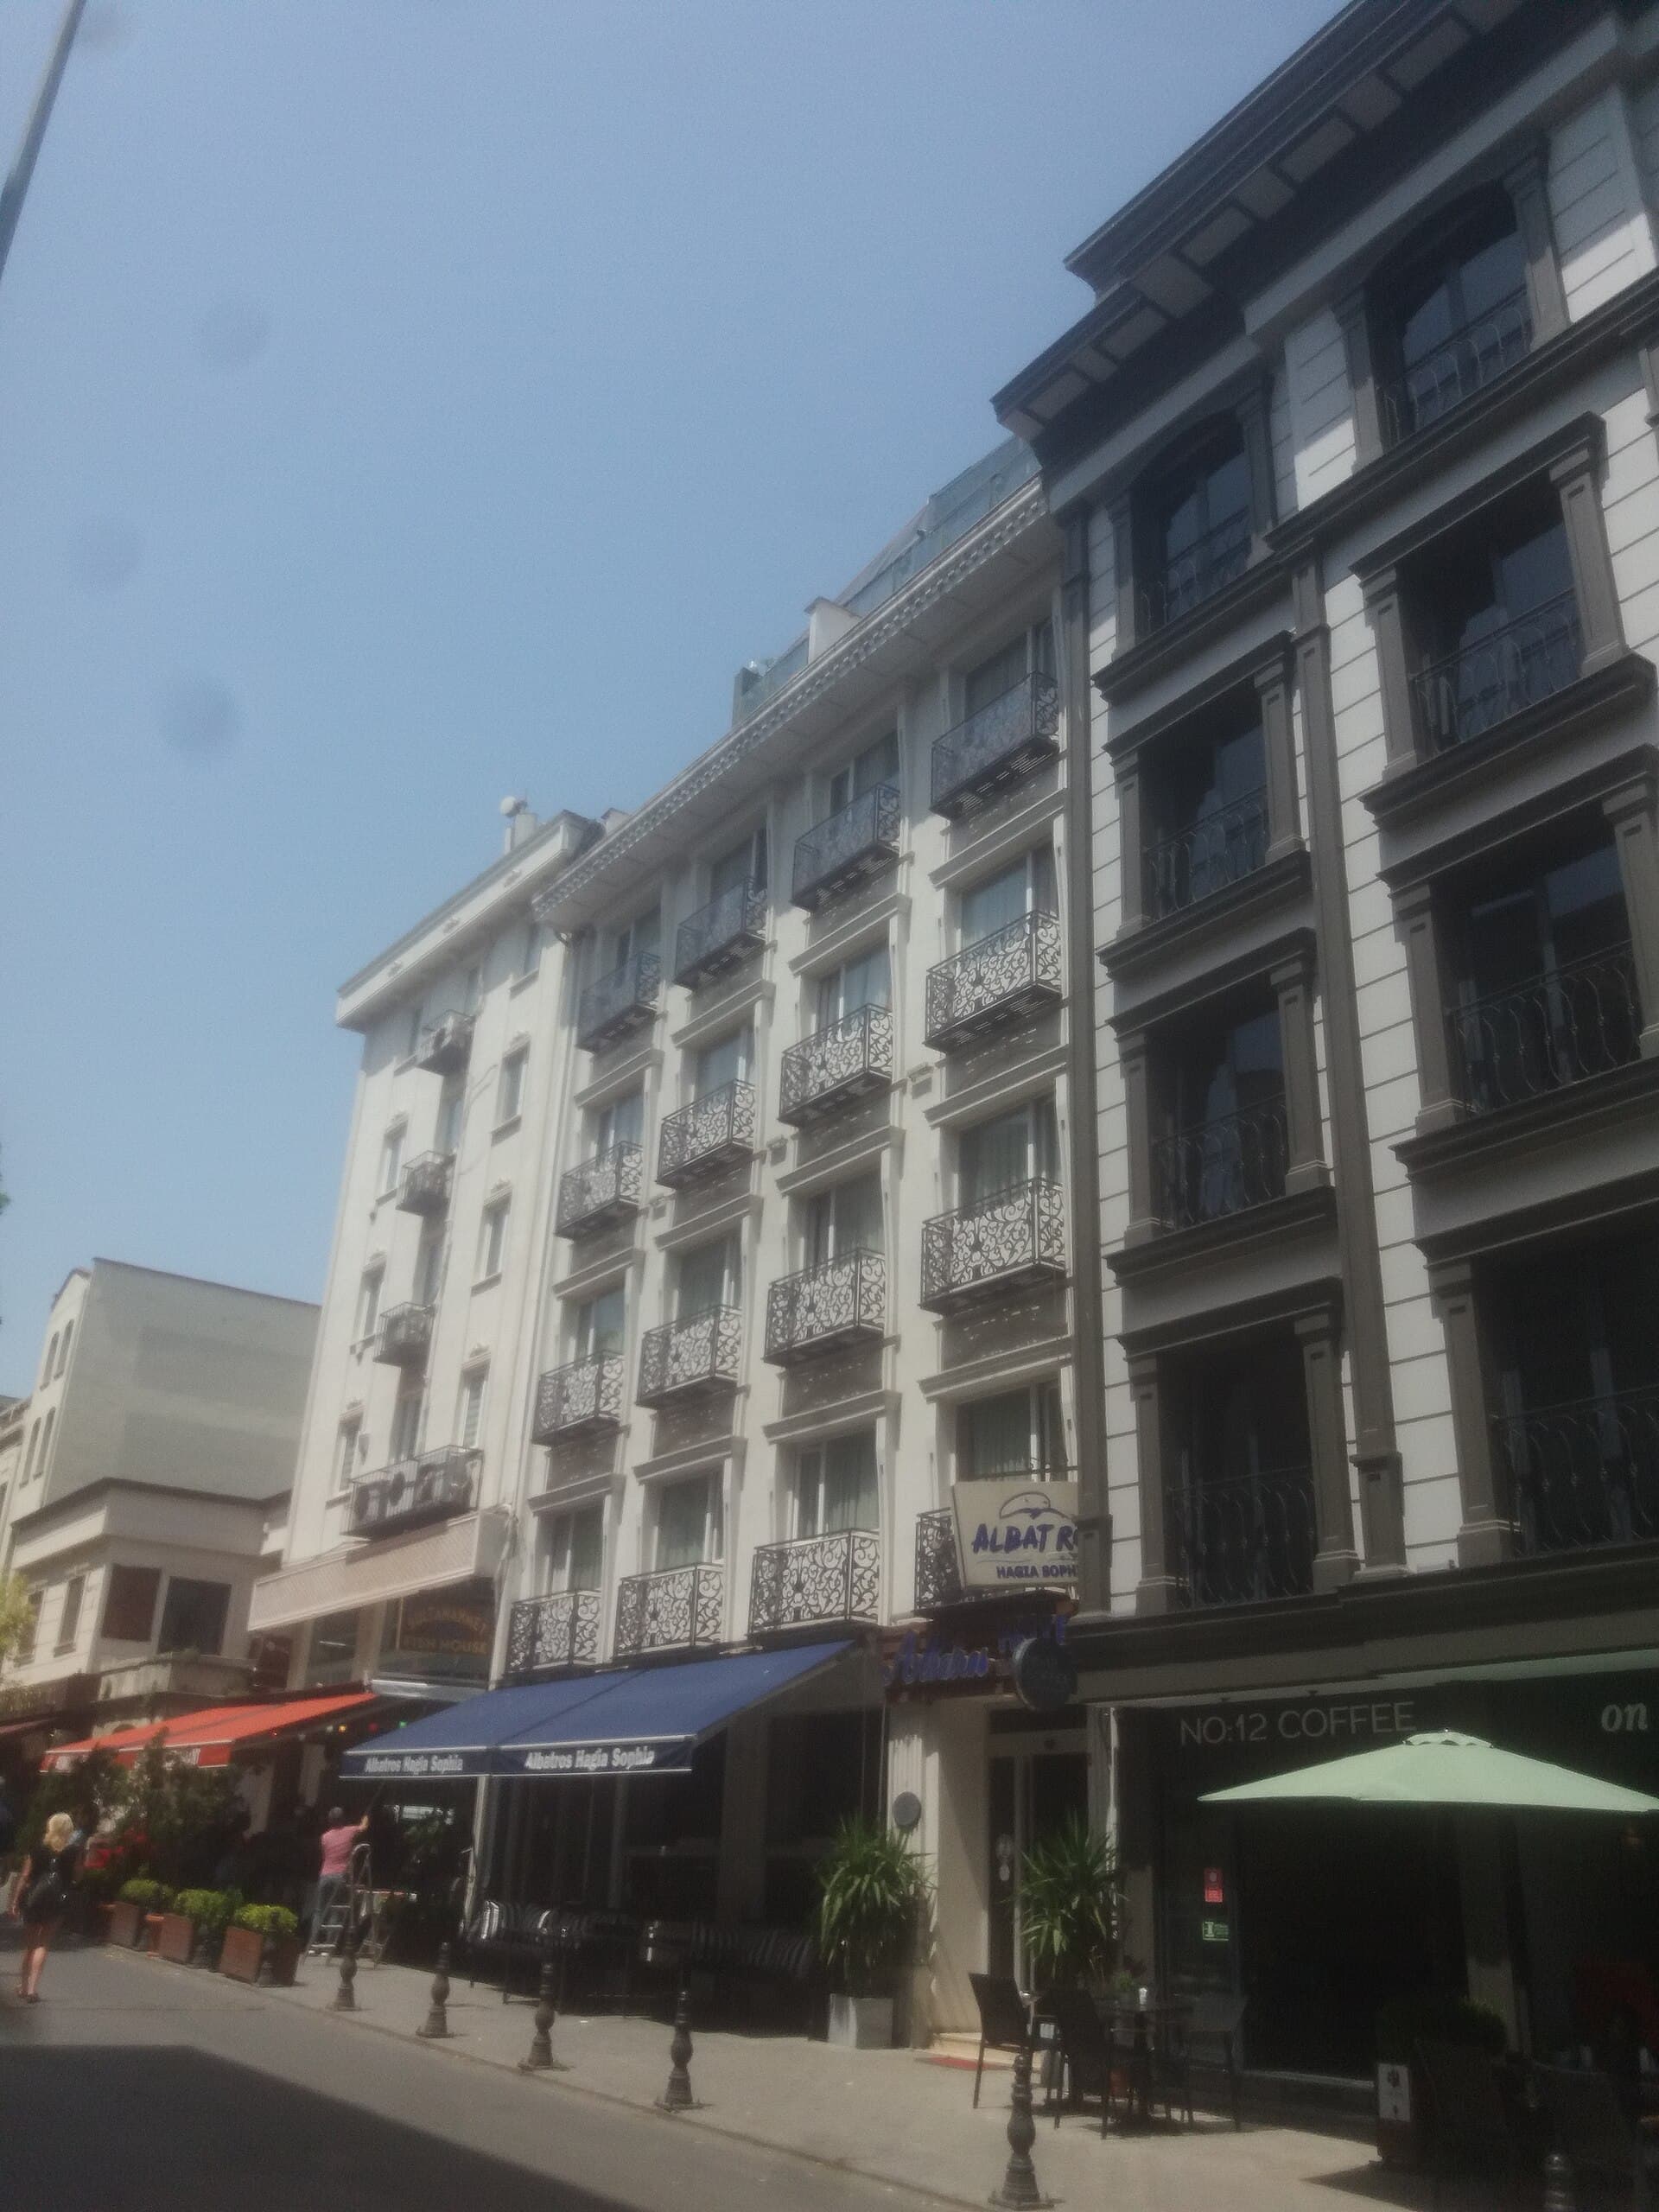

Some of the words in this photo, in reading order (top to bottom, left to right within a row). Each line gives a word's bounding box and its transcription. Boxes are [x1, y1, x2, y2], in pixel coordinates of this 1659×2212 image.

[1042, 1565, 1077, 1578] SOPH
[1278, 1700, 1417, 1739] COFFEE
[1601, 1702, 1648, 1732] on
[364, 1757, 402, 1772] Albatros
[430, 1754, 464, 1775] Sophia
[524, 1751, 573, 1770] Albatros
[575, 1748, 608, 1770] Hagia
[612, 1745, 655, 1770] Sophia
